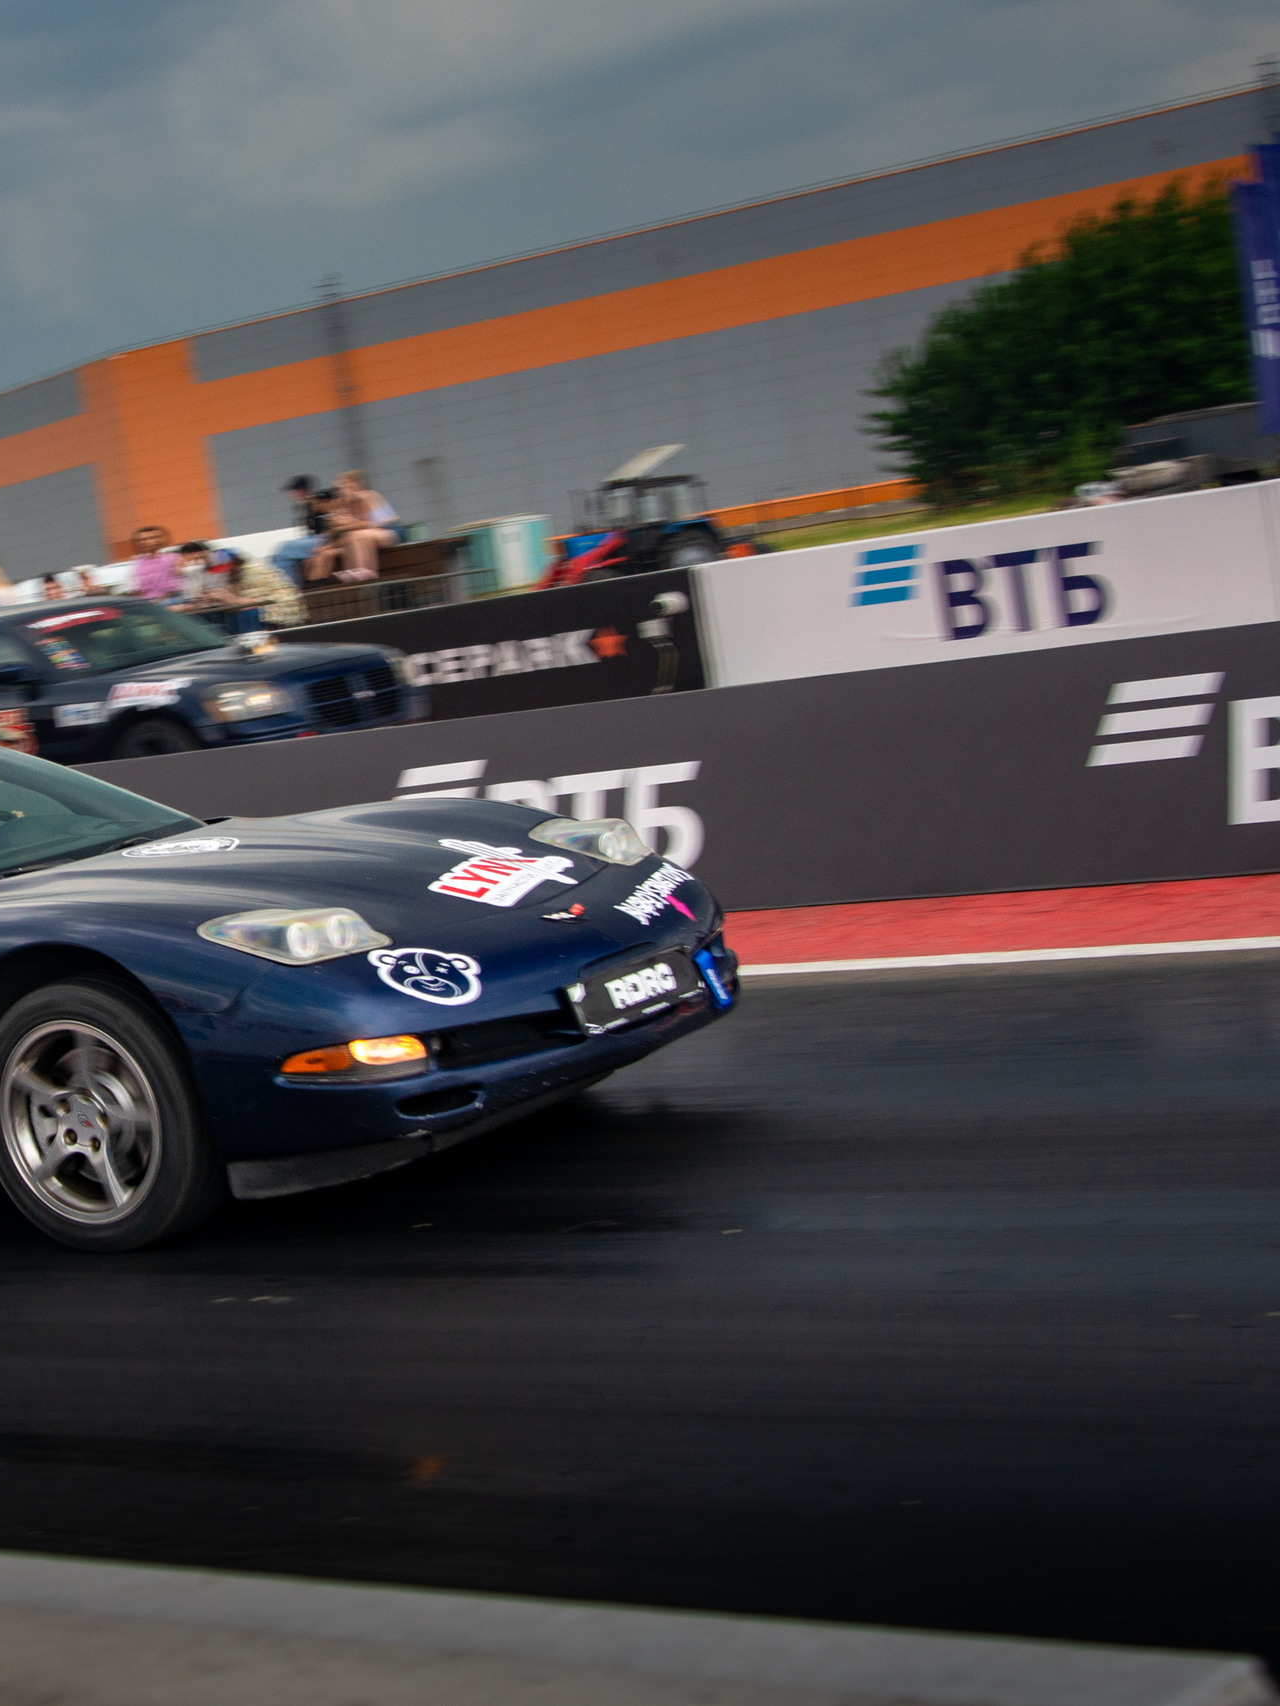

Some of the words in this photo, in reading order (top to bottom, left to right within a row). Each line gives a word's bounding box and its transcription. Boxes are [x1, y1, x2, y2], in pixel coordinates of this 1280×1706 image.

[928, 541, 1116, 641] ВТБ
[405, 629, 601, 687] CEPARK
[604, 962, 677, 1009] RDRC
